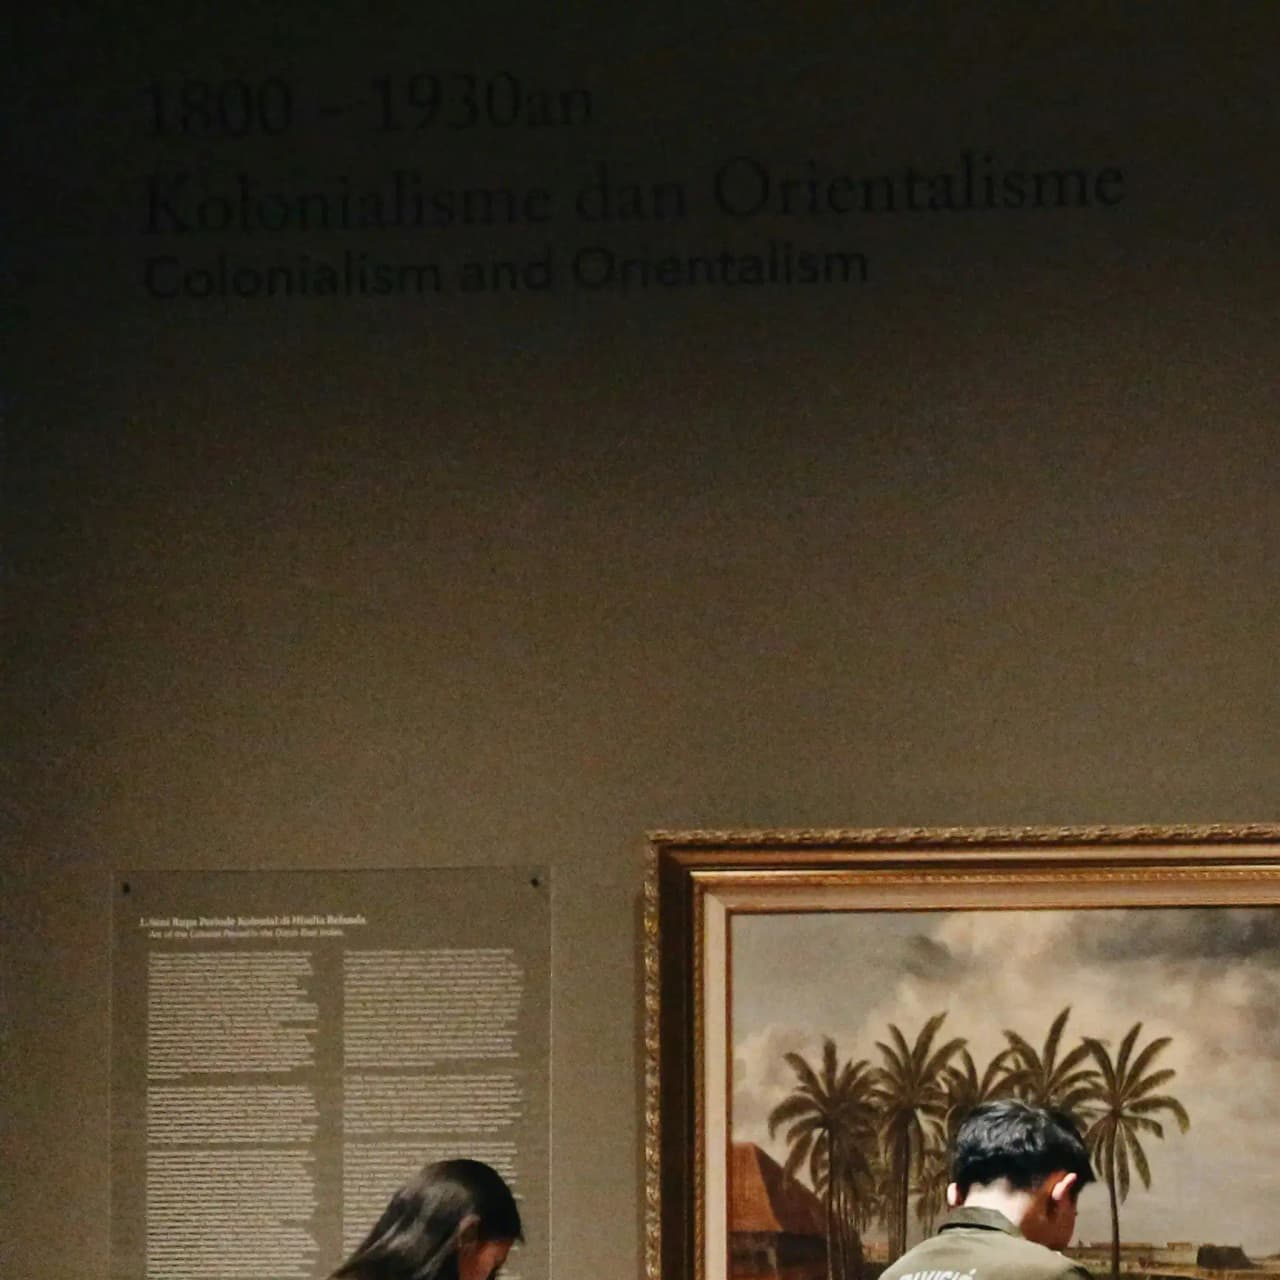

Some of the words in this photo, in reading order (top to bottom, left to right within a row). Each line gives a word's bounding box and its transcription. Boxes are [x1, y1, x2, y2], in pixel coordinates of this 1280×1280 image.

[145, 77, 294, 138] 1800
[370, 71, 594, 132] 1930an
[142, 168, 553, 236] Kolonialisme
[575, 160, 687, 224] dan
[713, 147, 1127, 218] Orientalisme
[144, 249, 442, 299] Colonialism
[460, 243, 553, 293] and
[571, 240, 869, 291] Orientalism
